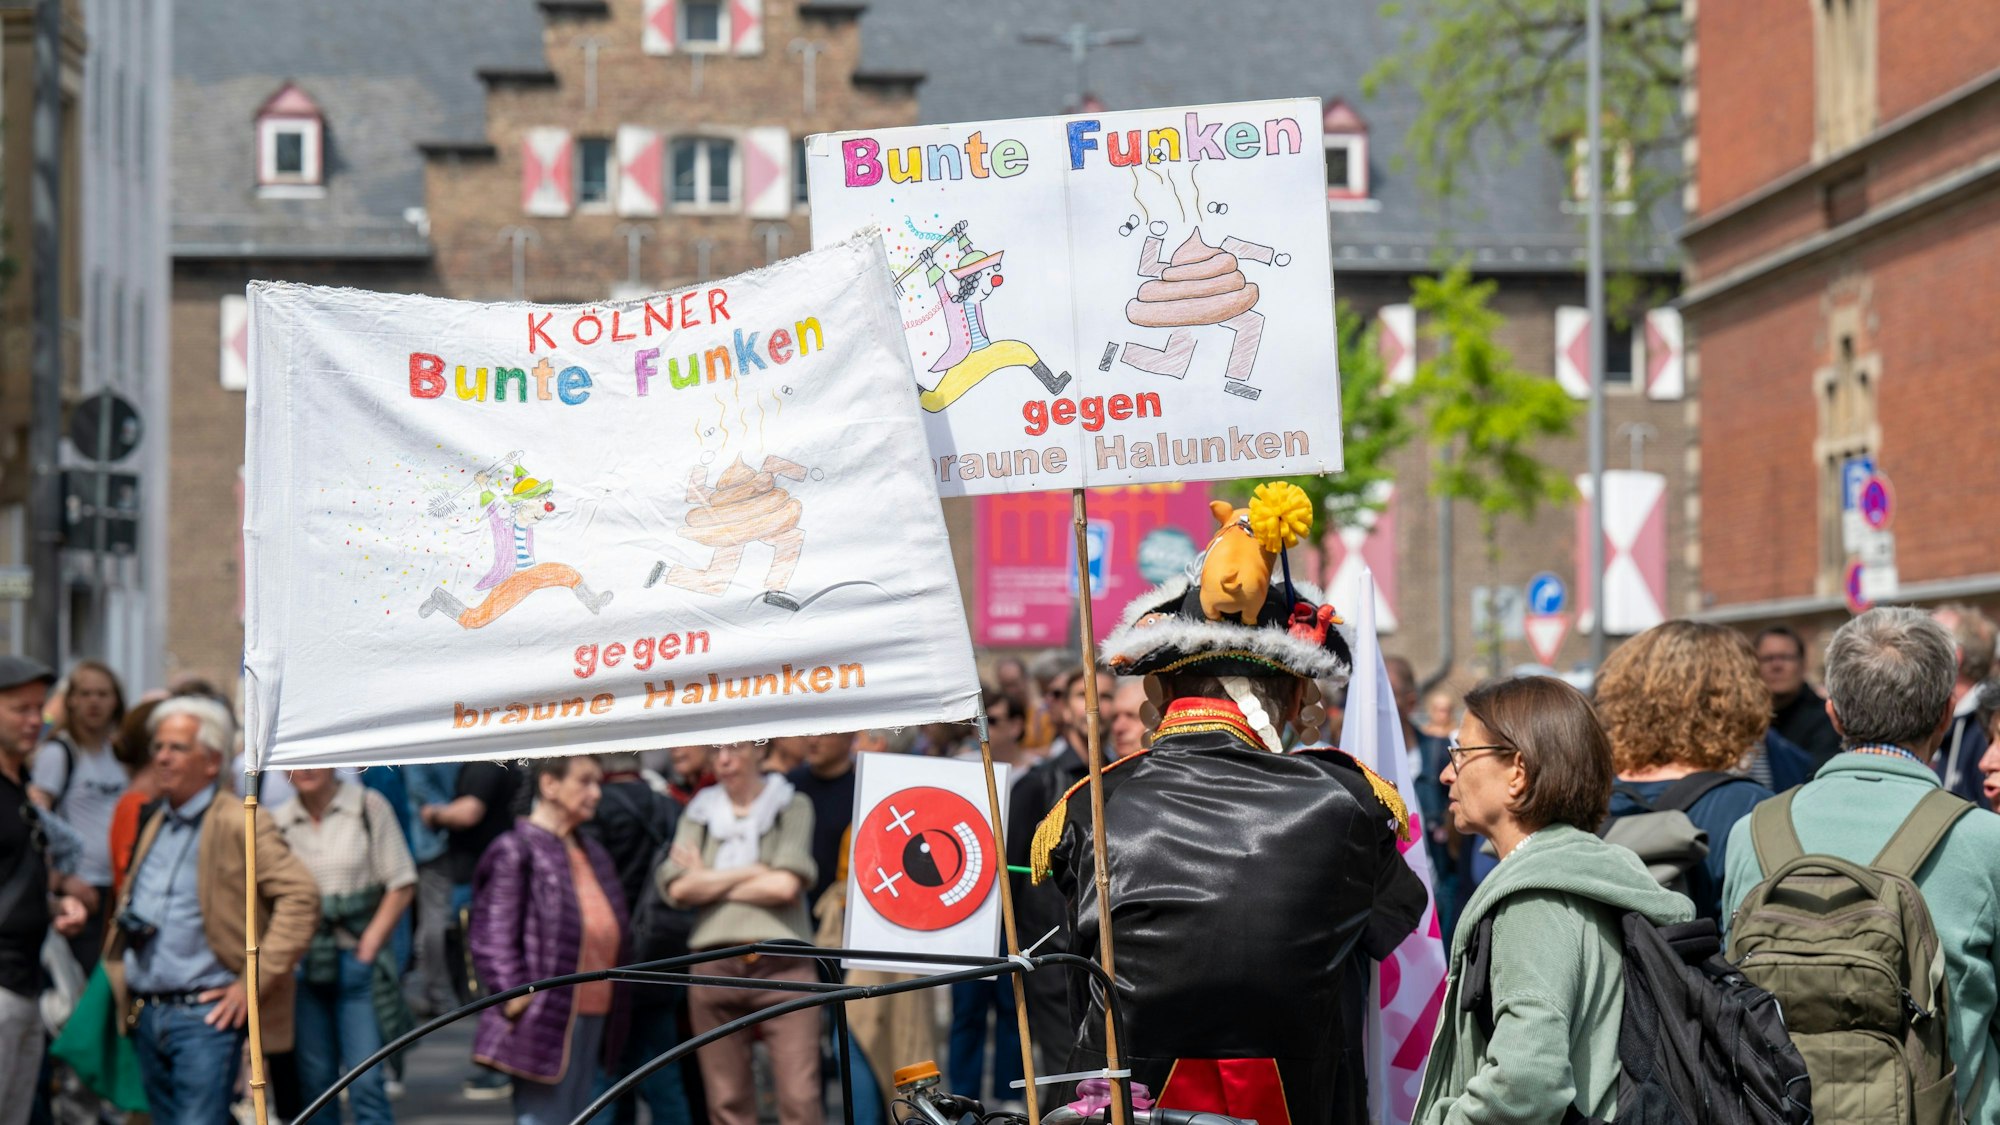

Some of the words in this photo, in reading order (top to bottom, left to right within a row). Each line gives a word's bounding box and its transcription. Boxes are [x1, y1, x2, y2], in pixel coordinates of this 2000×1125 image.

[842, 131, 1029, 188] Bunte
[1066, 112, 1302, 170] Funken
[528, 288, 732, 353] KÖLNER
[408, 351, 593, 406] Bunte
[635, 315, 826, 397] Funken
[1022, 391, 1163, 436] gegen
[932, 445, 1068, 482] raune
[1094, 426, 1310, 470] Halunken
[573, 628, 712, 679] gegen
[452, 691, 615, 729] braune
[643, 662, 867, 710] Halunken
